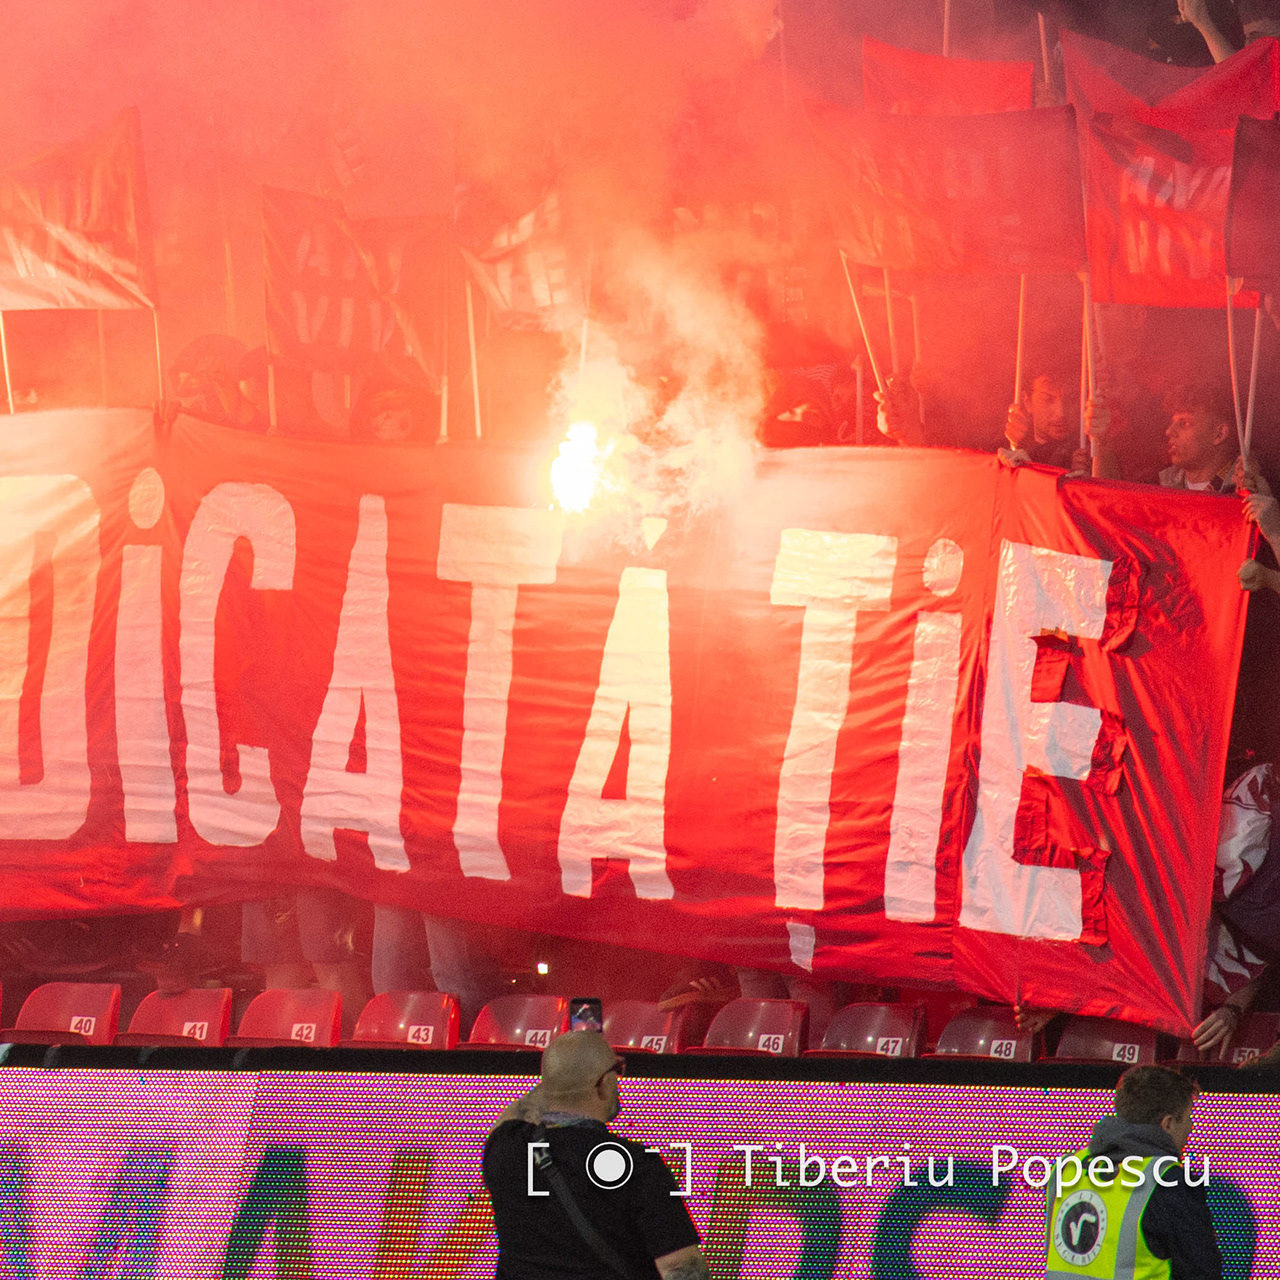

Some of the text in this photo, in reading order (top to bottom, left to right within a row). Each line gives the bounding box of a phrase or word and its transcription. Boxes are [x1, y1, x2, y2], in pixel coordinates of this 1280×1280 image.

[73, 1018, 93, 1033] 40
[186, 1022, 206, 1038] 41
[293, 1024, 314, 1040] 42
[411, 1027, 431, 1042] 43
[528, 1032, 547, 1047] 44
[644, 1036, 663, 1052] 45
[761, 1035, 780, 1051] 46
[880, 1039, 899, 1054] 47
[993, 1041, 1013, 1057] 48
[1116, 1045, 1136, 1060] 49
